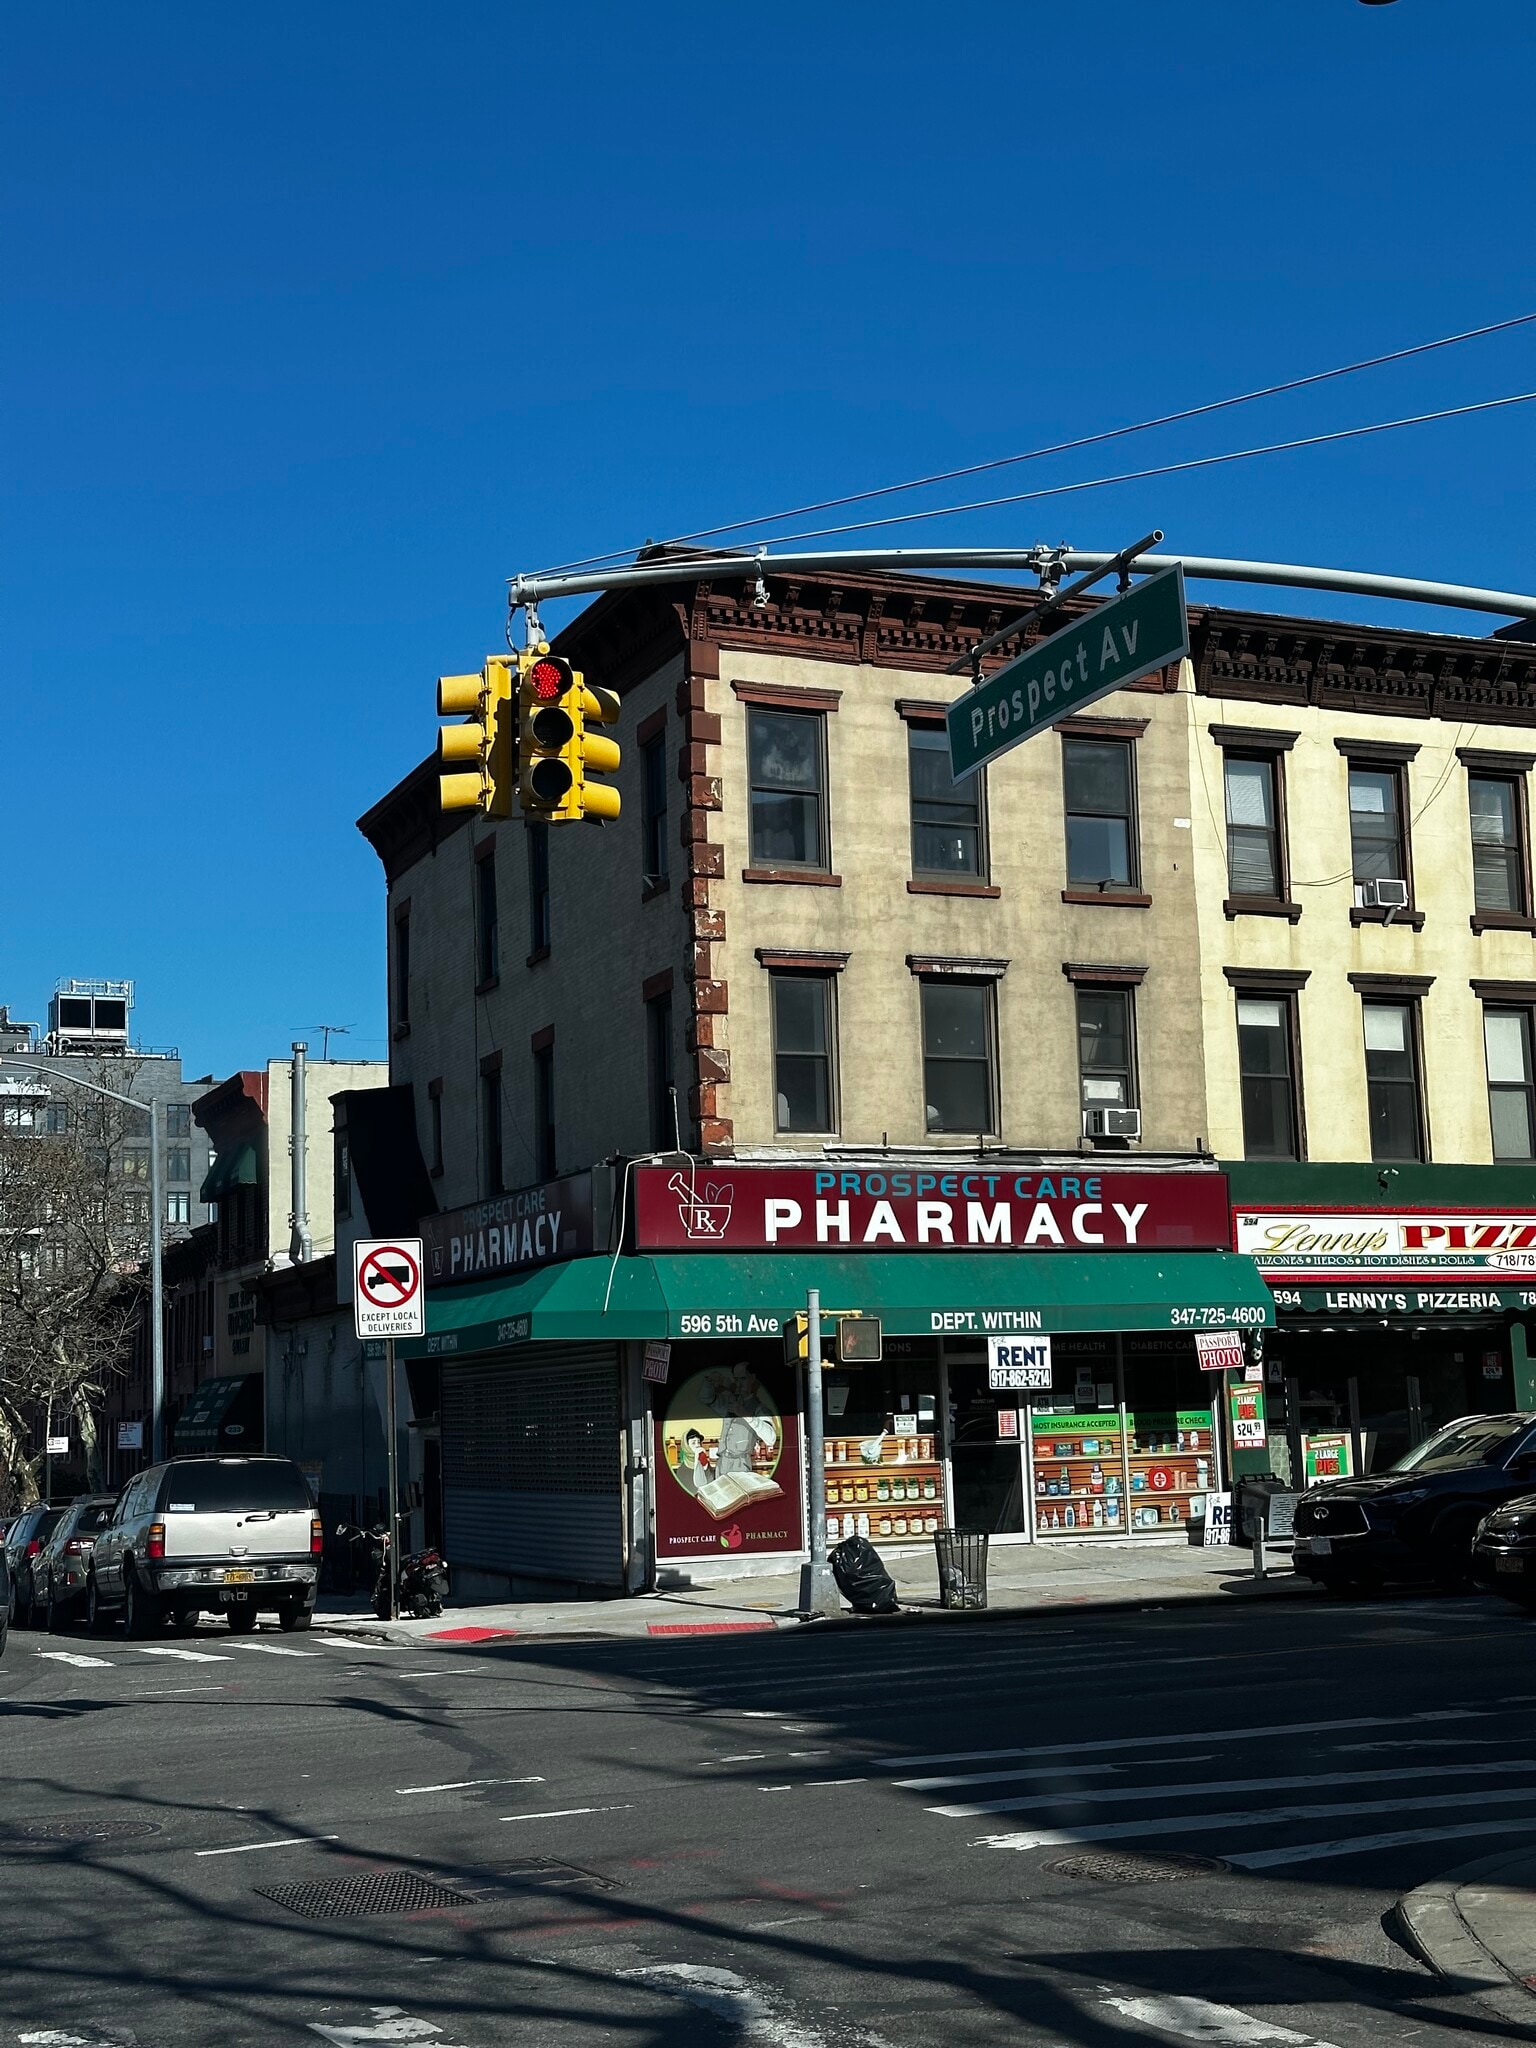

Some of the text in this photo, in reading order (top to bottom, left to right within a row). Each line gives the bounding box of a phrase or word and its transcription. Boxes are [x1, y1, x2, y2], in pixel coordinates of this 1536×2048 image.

[971, 619, 1139, 749] Prospect Av
[815, 1172, 1102, 1199] PROSPECT CARE
[463, 1188, 546, 1230] PROSPECT CARE
[764, 1198, 1149, 1244] PHARMACY
[1243, 1217, 1259, 1226] 594
[450, 1210, 562, 1275] PHARMACY
[1251, 1223, 1536, 1254] Lenny's PIZZ
[1251, 1255, 1475, 1265] ALZONES HEROS HOT DISHES ROLLS
[1496, 1254, 1536, 1266] 718/78
[1273, 1290, 1536, 1309] 594 LENNY'S PIZZERIA 78
[361, 1311, 419, 1322] EXCEPT LOCAL
[680, 1314, 779, 1333] 596 5th Ave
[931, 1311, 1042, 1330] DEPT. WITHIN
[1170, 1306, 1266, 1324] 347-725-4600
[368, 1322, 413, 1332] DELIVERIES
[1070, 1342, 1106, 1351] HEALTH
[1129, 1341, 1197, 1350] DIABETIC CAR
[1199, 1335, 1238, 1349] PASSPORT
[997, 1346, 1047, 1367] RENT
[1201, 1348, 1241, 1368] PHOTO
[644, 1359, 667, 1380] PHOTO
[991, 1369, 1050, 1387] 917-862-5214
[1087, 1420, 1117, 1428] ACCEPTED
[1130, 1418, 1152, 1426] BLOOD
[1184, 1416, 1207, 1424] CHECK
[1320, 1449, 1339, 1459] LARGE
[1316, 1459, 1340, 1476] PIES
[1212, 1505, 1232, 1525] RE
[669, 1531, 788, 1544] PROSPECT CARE PHARMACY
